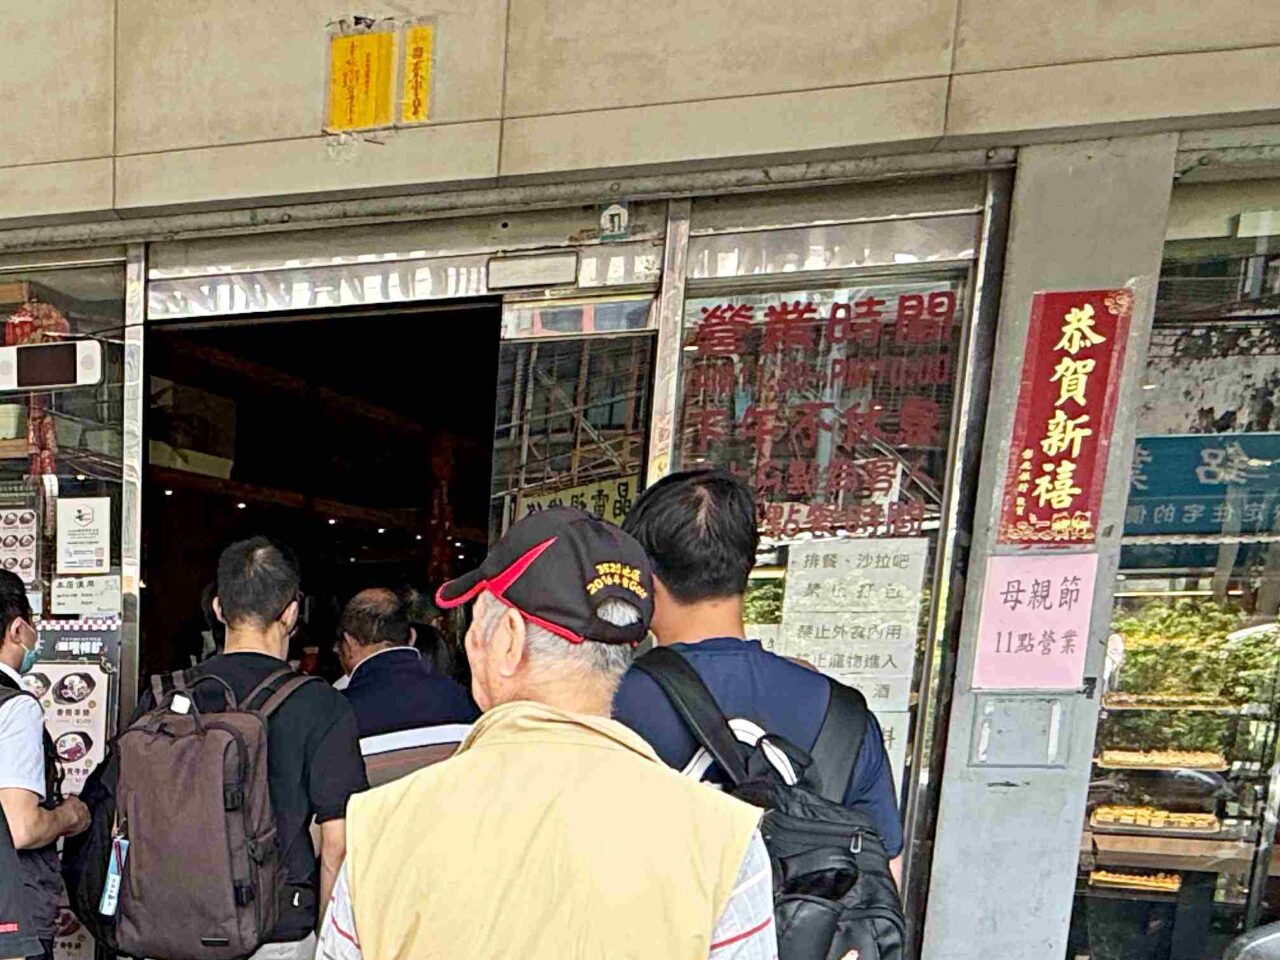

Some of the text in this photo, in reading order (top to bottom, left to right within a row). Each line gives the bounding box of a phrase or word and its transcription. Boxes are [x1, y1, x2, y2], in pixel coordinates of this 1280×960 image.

[698, 290, 956, 354] 營業時間
[1031, 303, 1107, 510] 恭賀新禧
[999, 575, 1082, 612] 母親節
[995, 628, 1079, 655] 11點營業
